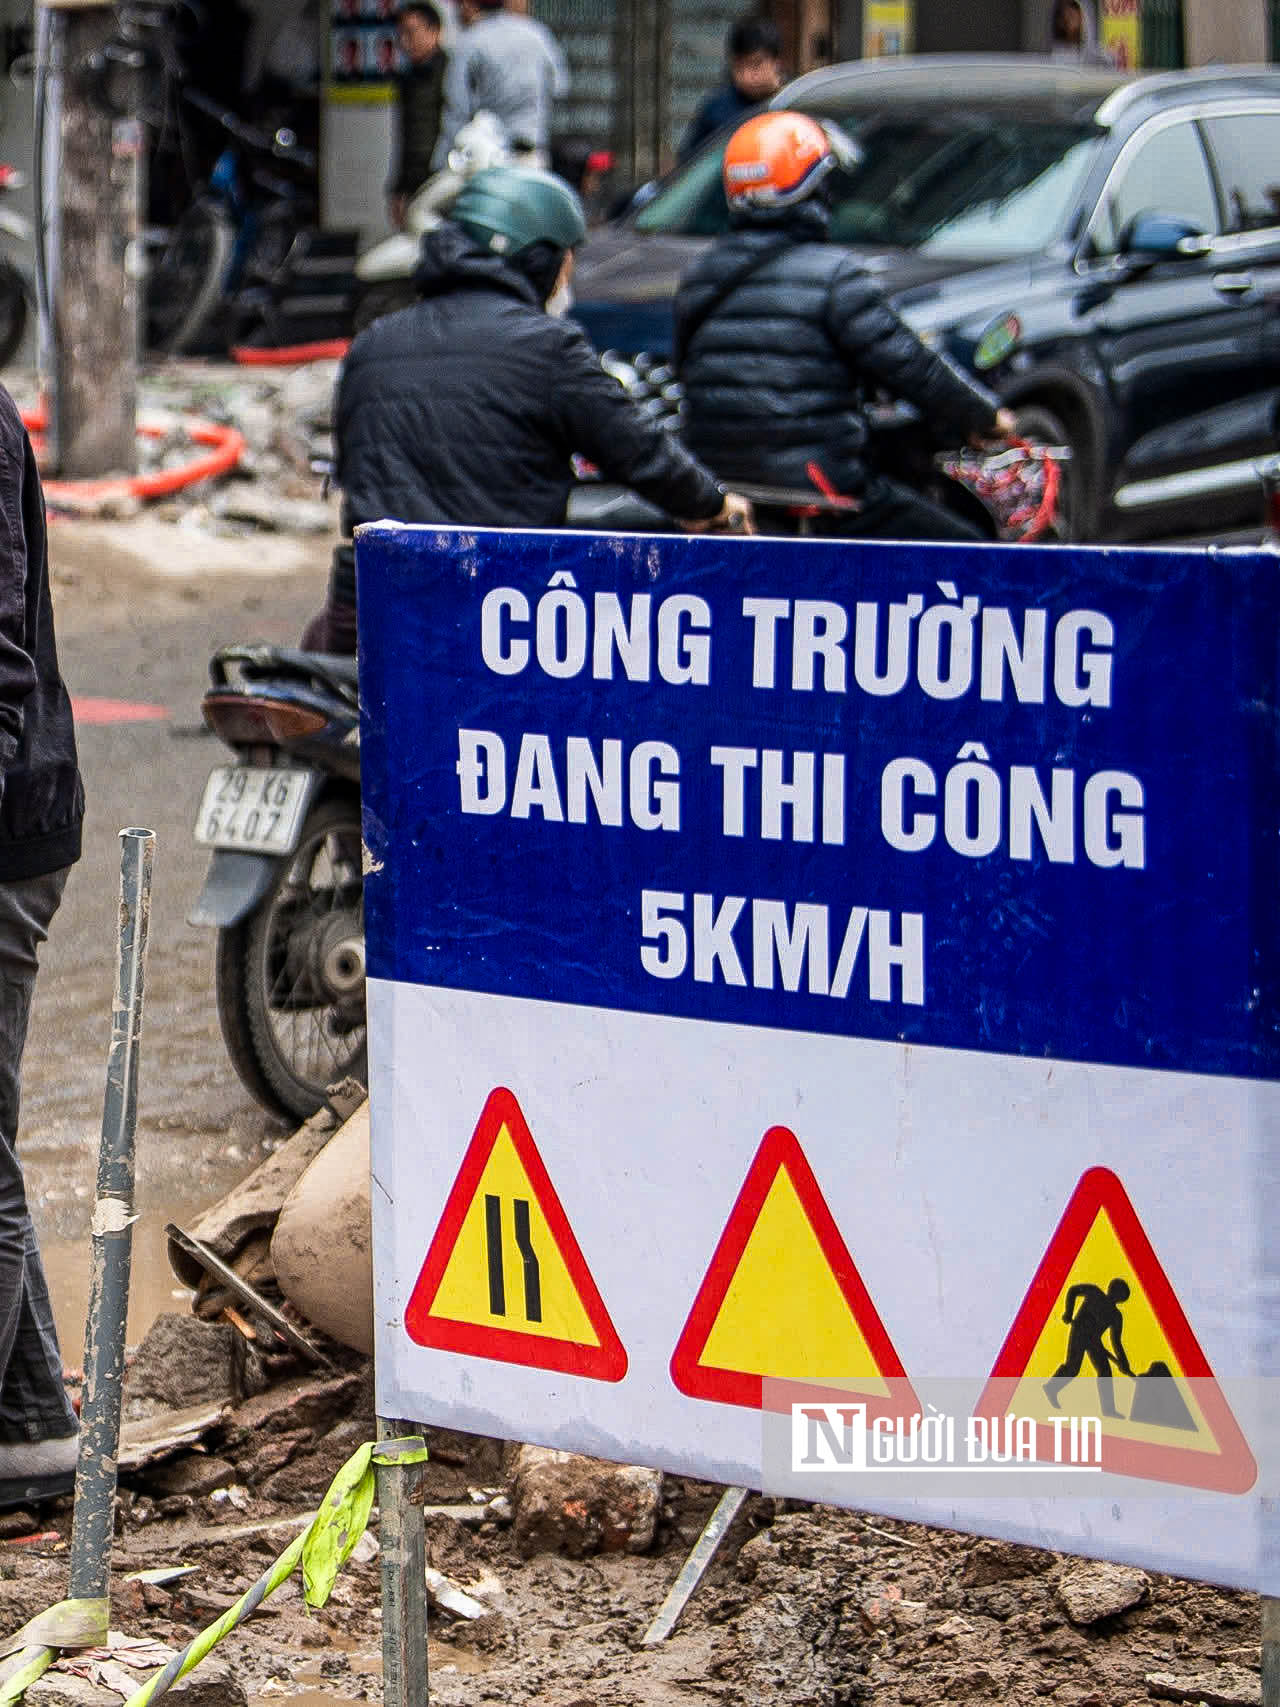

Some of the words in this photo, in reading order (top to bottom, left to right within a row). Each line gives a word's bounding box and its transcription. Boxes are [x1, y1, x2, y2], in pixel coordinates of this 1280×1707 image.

[481, 570, 711, 687] CÔNG
[743, 581, 1114, 709] TRƯỜNG
[456, 728, 681, 833] ĐANG
[711, 745, 846, 845] THI
[880, 742, 1147, 870] CÔNG
[640, 889, 925, 1007] 5KM/H
